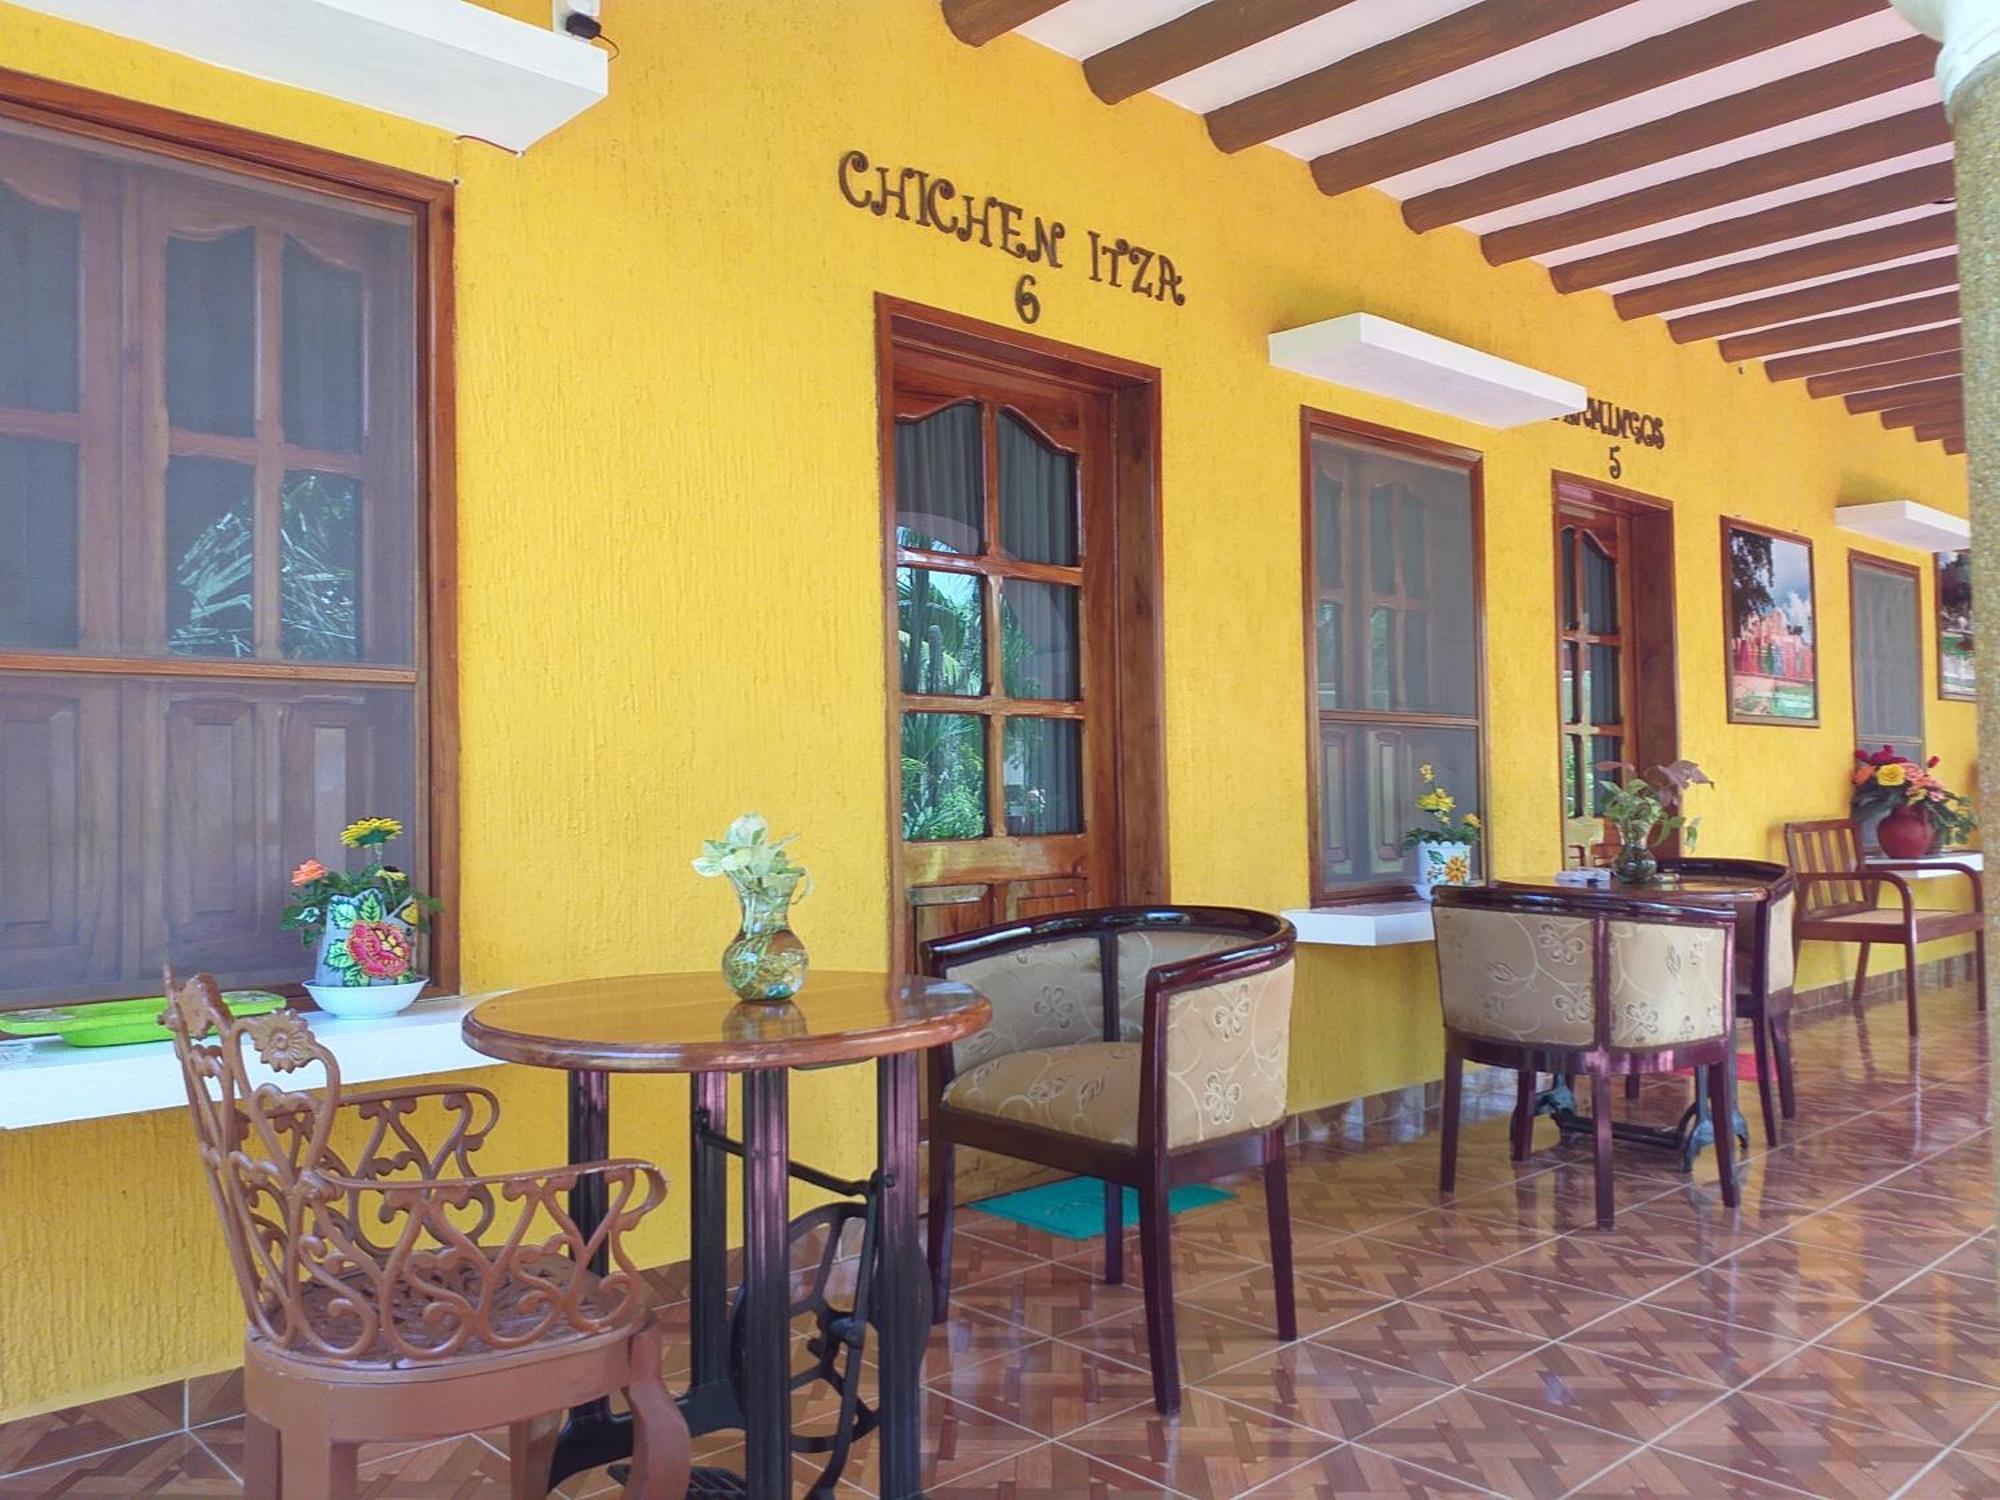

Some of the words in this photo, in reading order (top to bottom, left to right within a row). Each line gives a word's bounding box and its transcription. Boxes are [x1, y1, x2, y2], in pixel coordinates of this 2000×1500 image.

[838, 150, 1065, 268] CHICHEN
[1087, 230, 1185, 306] ITZA
[1015, 274, 1041, 324] 6
[1609, 446, 1622, 479] 5
